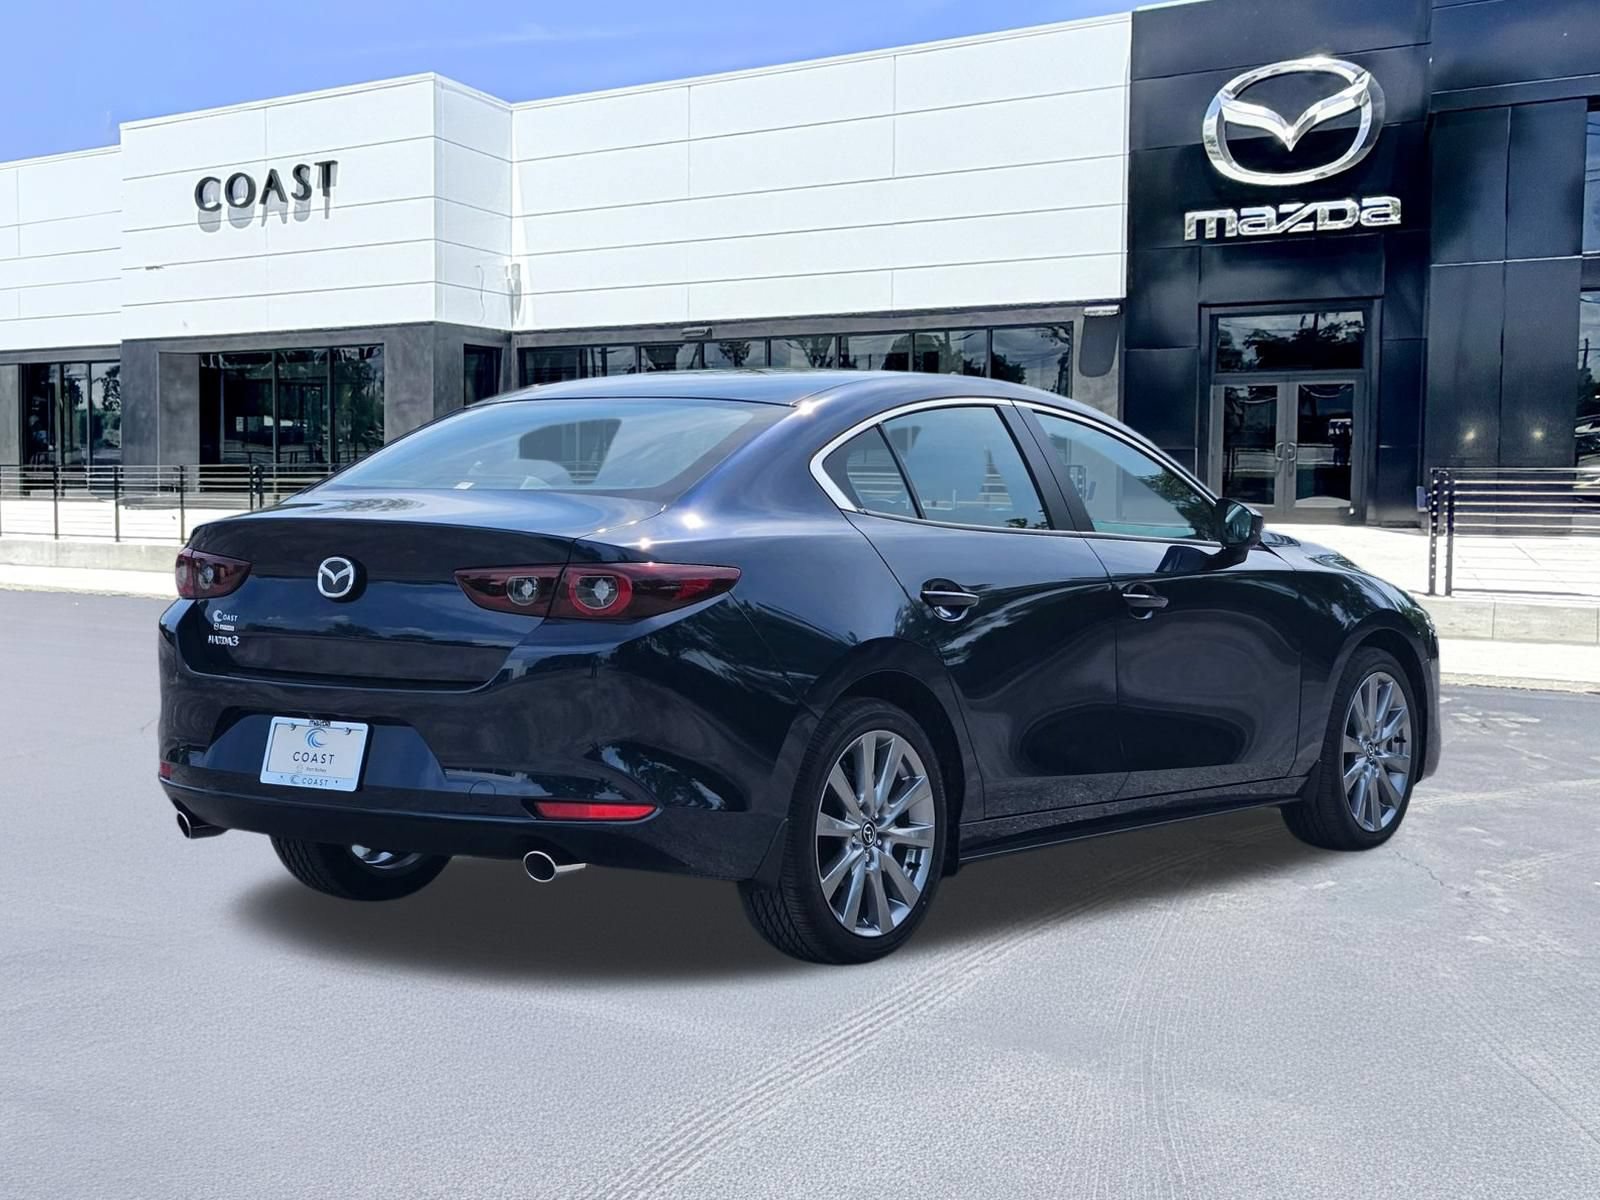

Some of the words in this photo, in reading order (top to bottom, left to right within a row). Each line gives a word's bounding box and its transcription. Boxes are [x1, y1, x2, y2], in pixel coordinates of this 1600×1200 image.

[194, 160, 338, 212] COAST
[1184, 195, 1401, 241] mazda
[292, 751, 335, 765] COAST
[302, 777, 329, 786] COAST
